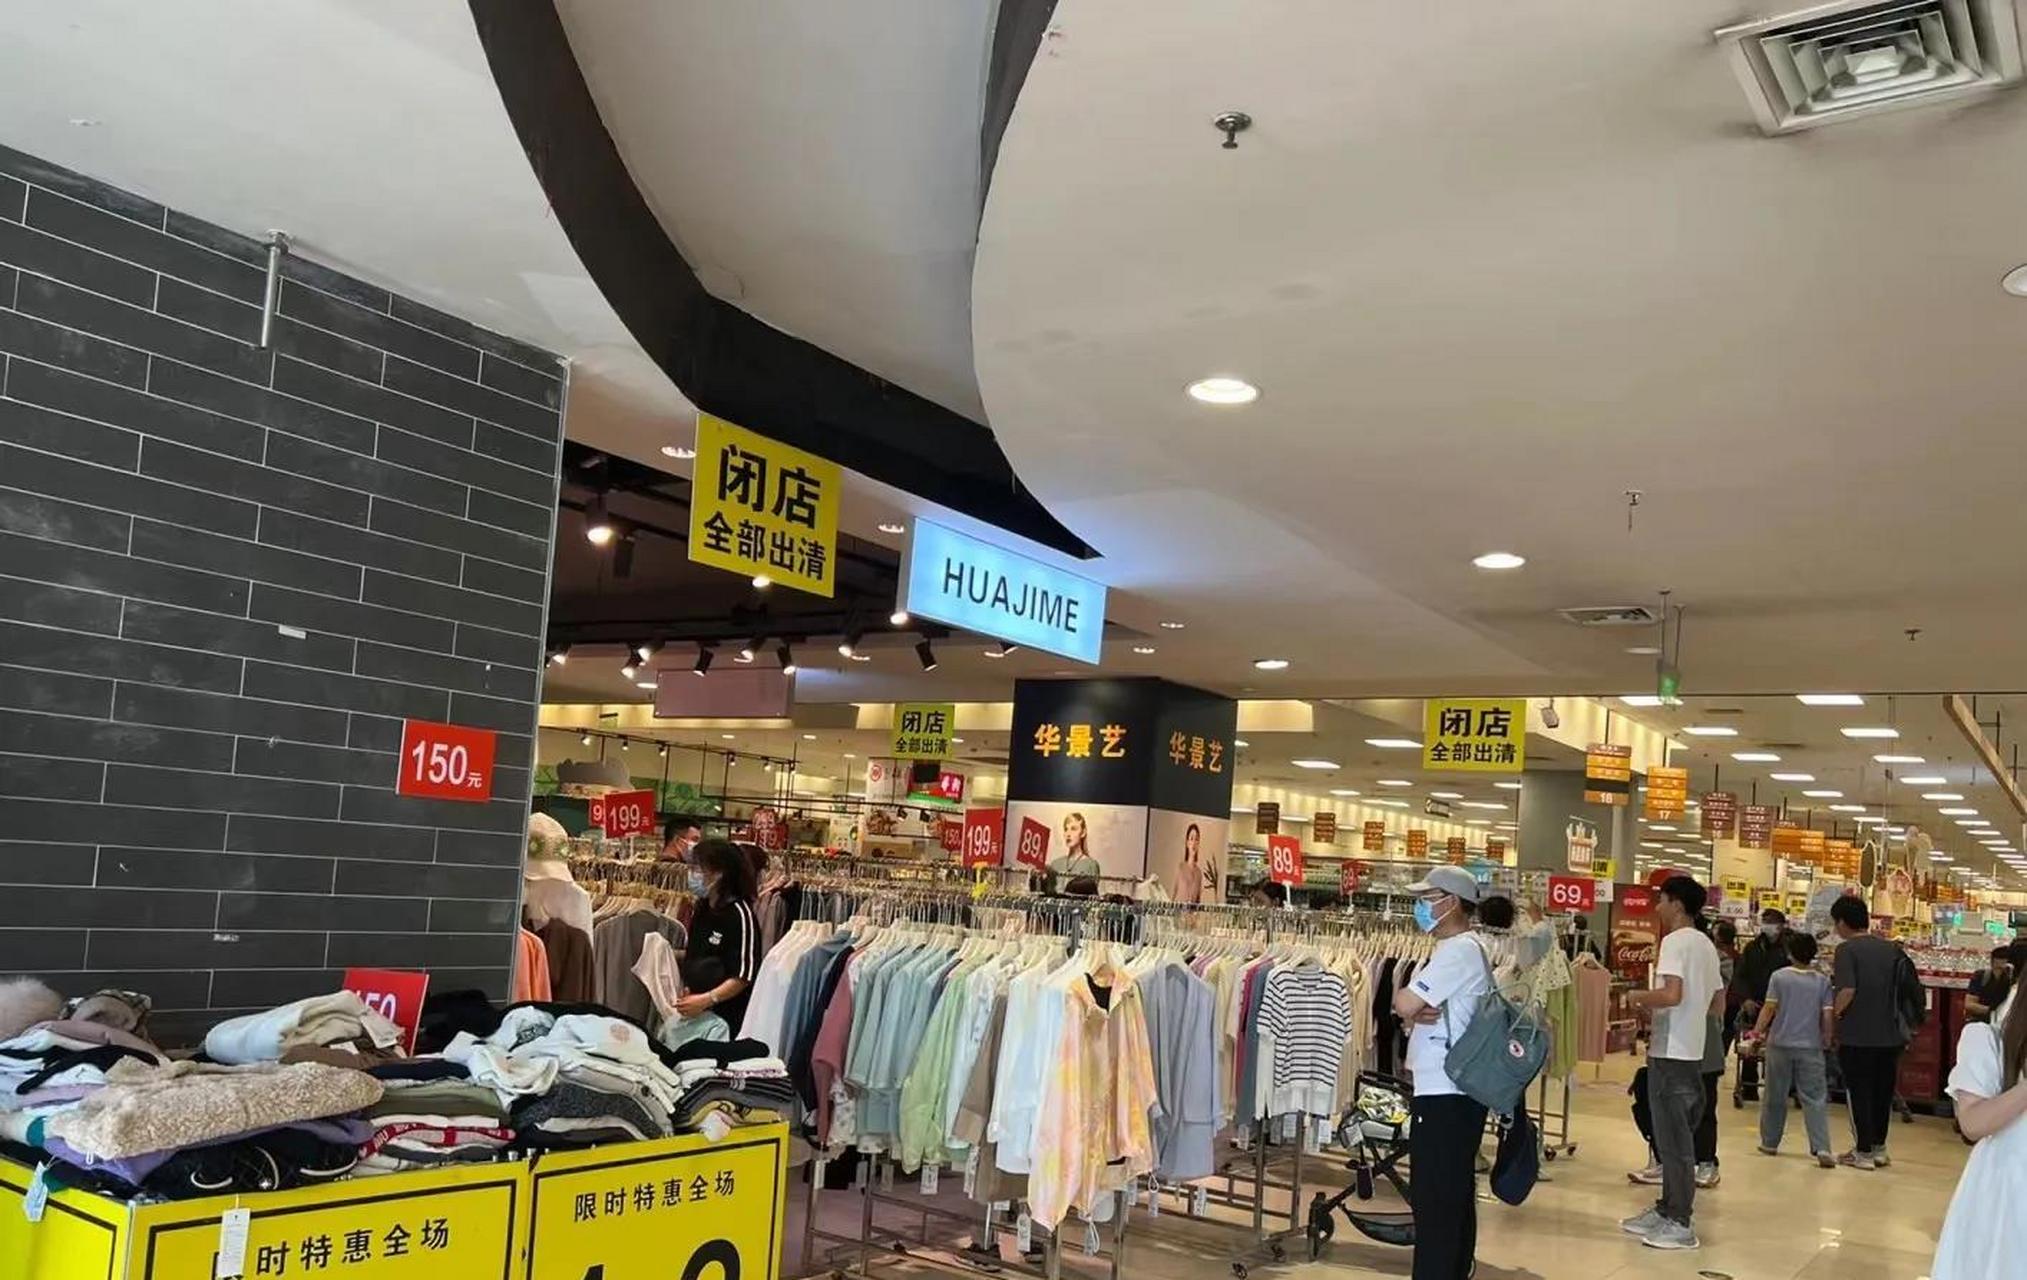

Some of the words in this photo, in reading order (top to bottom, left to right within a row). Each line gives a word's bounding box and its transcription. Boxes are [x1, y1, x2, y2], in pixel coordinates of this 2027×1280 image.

[718, 444, 821, 530] 闭店
[704, 511, 826, 581] 全部出清
[943, 557, 1079, 633] HUAJIME
[902, 711, 945, 734] 闭店
[1033, 723, 1127, 758] 华景艺
[1440, 708, 1511, 738] 闭店
[412, 740, 482, 789] 150元
[895, 737, 947, 754] 全部出清
[1169, 731, 1223, 773] 华景艺
[1431, 742, 1516, 763] 全部出清
[1660, 810, 1671, 820] 17
[574, 1170, 735, 1222] 限时特惠全场
[211, 1218, 448, 1280] 时特惠全场
